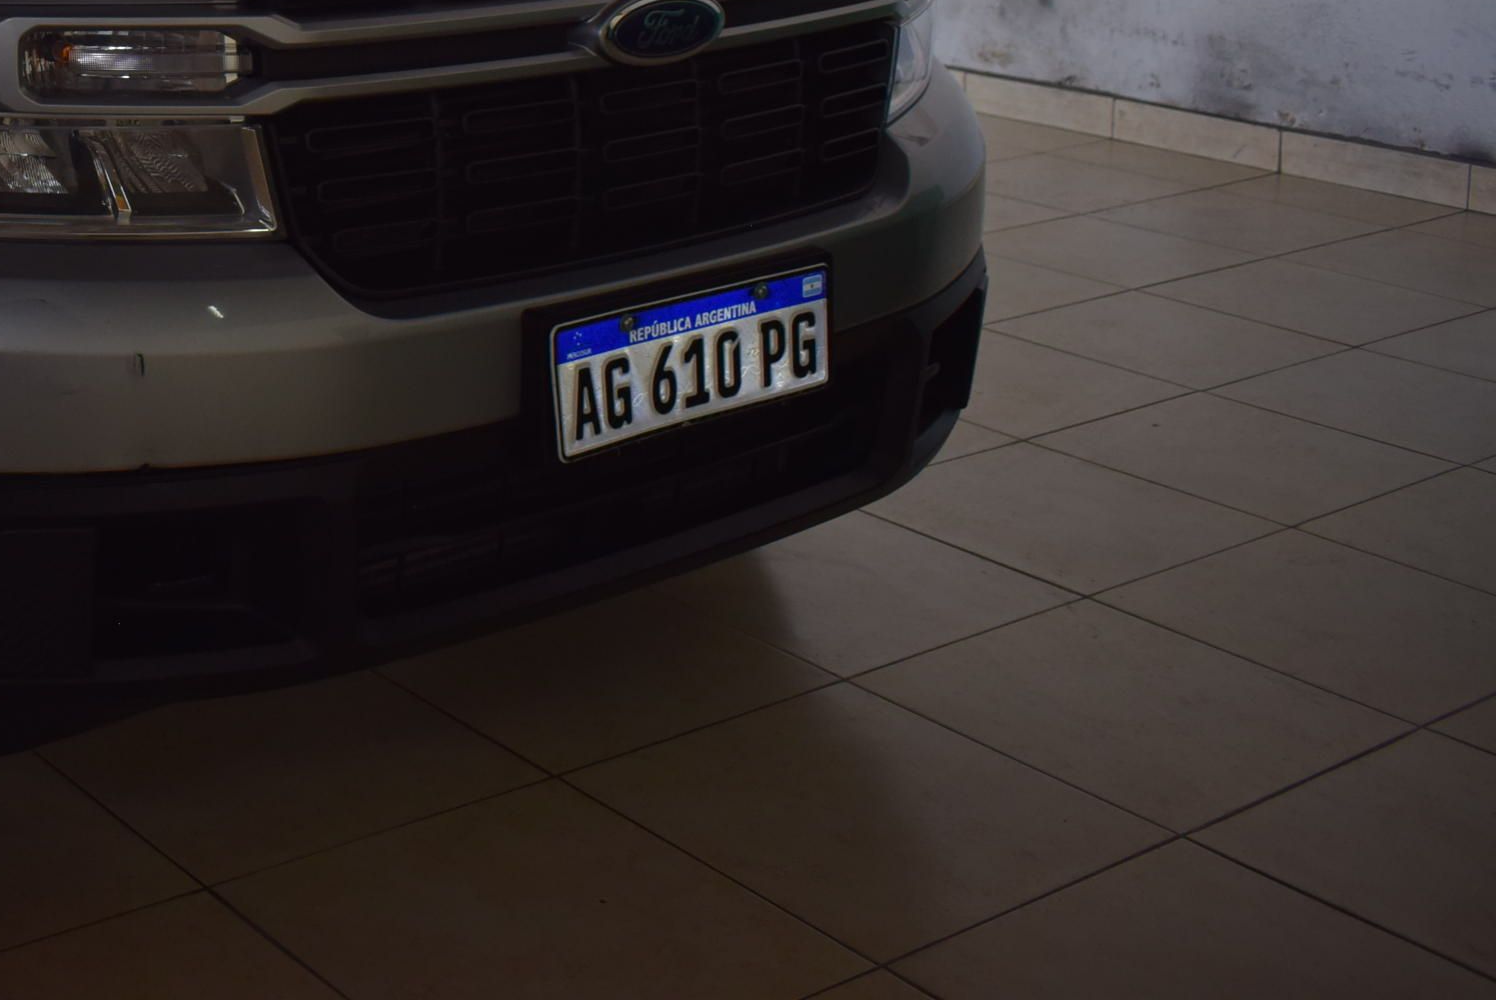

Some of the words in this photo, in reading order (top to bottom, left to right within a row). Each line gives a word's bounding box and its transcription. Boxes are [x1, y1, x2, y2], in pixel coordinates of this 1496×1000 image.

[636, 8, 701, 50] Ford
[629, 316, 692, 344] REPÚBLICA
[694, 300, 757, 328] ARGENTINA
[575, 356, 633, 441] AG
[653, 329, 742, 416] 610
[760, 311, 817, 388] PG
